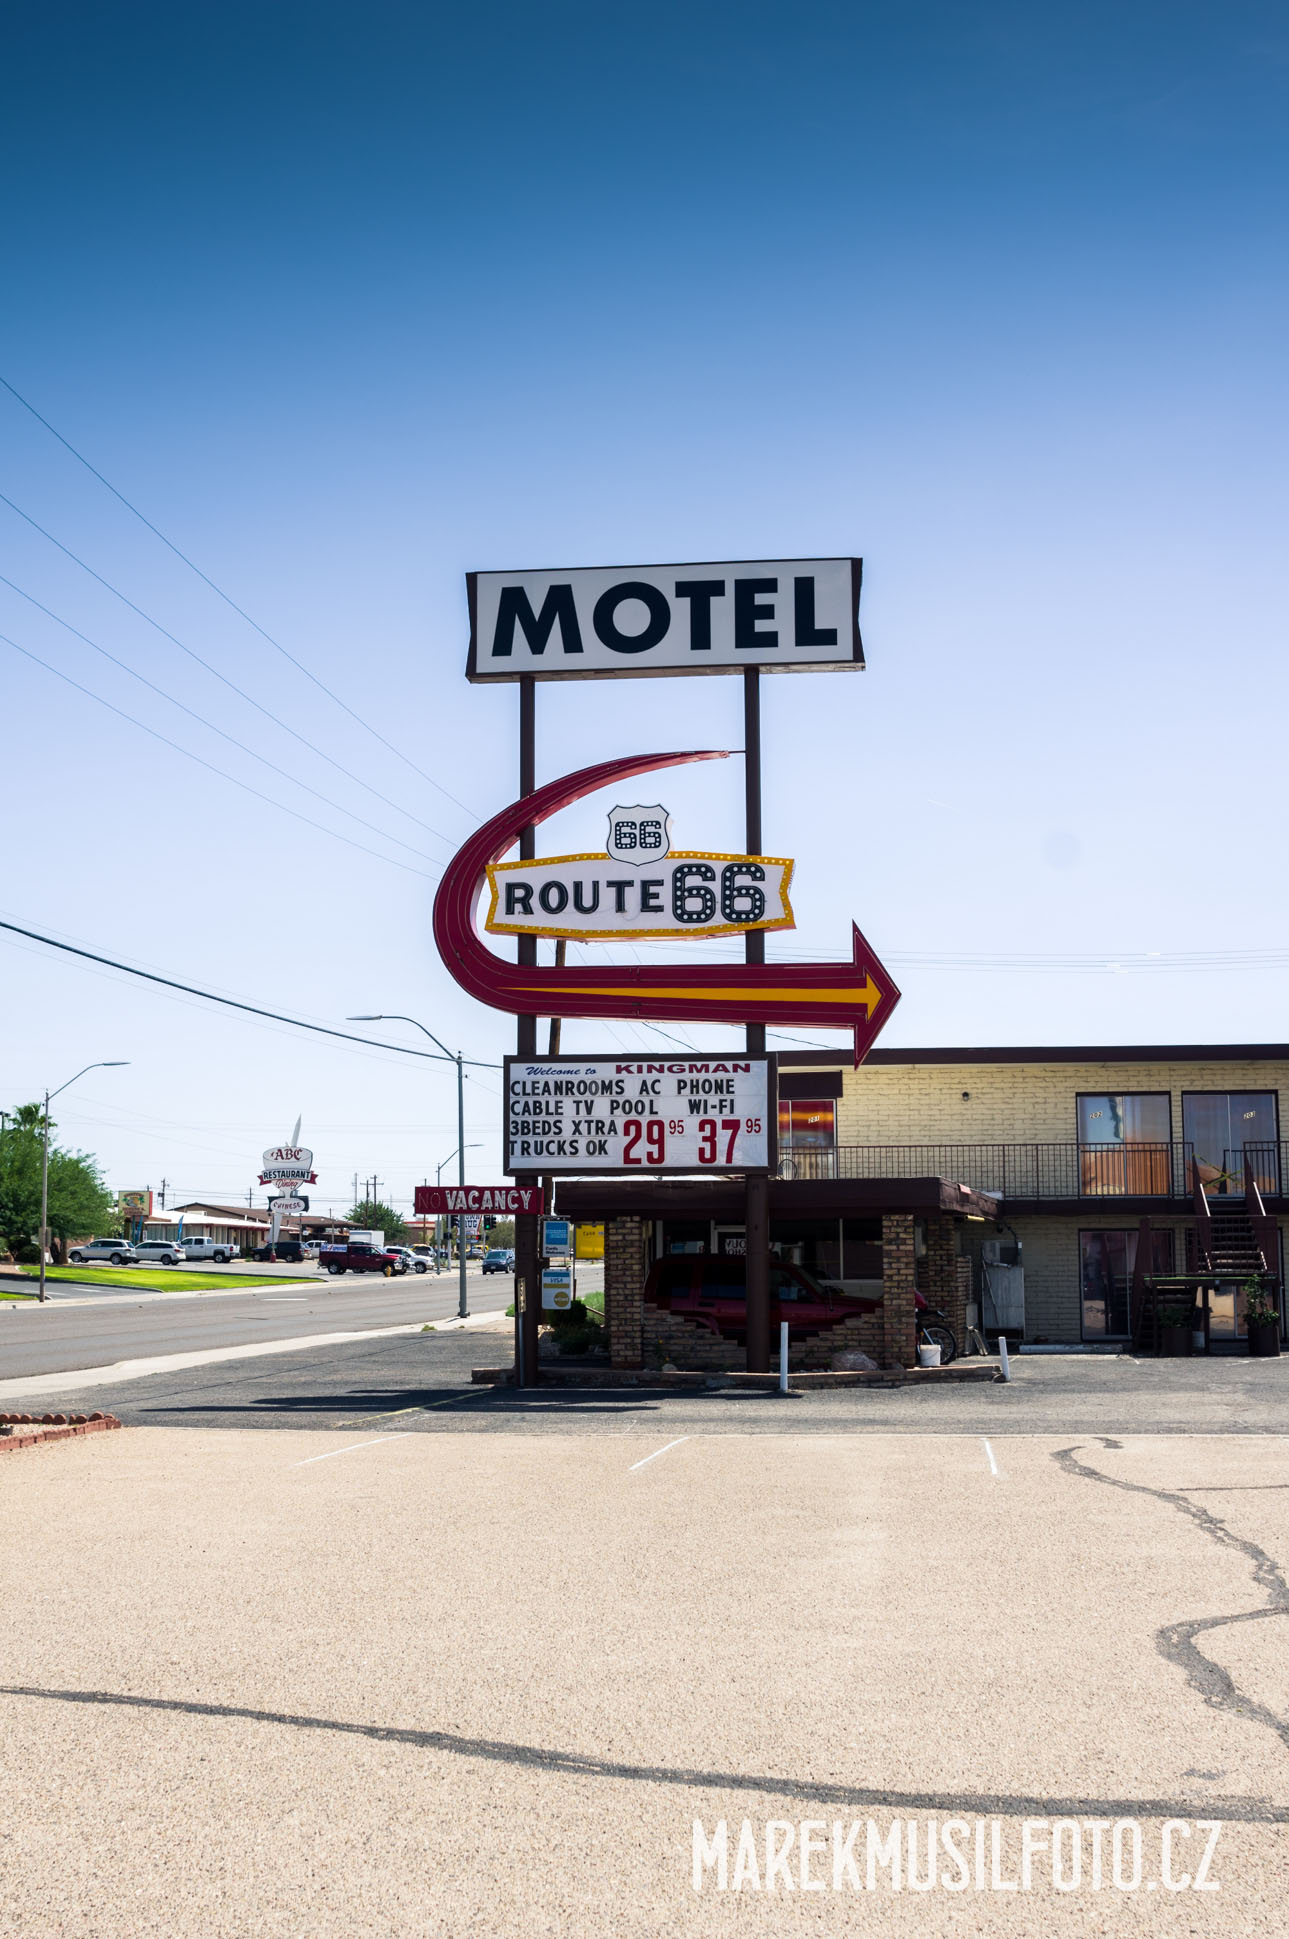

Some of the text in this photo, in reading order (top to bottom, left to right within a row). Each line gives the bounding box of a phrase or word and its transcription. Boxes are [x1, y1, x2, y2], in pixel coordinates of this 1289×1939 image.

[491, 576, 838, 657] MOTEL
[614, 821, 662, 850] 66
[505, 863, 766, 924] ROUTE 66
[525, 1063, 751, 1076] Welcome to KINGMAN
[510, 1078, 735, 1096] CLEANROOMS AC PHONE
[510, 1099, 735, 1116] CABLE TV POOL WI-FI
[510, 1119, 618, 1136] 3BEDS XTRA
[509, 1140, 609, 1156] TRUCKS OK
[623, 1118, 762, 1164] 29 95 37 95
[270, 1148, 303, 1161] ABC
[263, 1170, 311, 1180] RESTAURANT
[275, 1179, 299, 1190] Dining
[273, 1201, 303, 1210] CHINESE
[418, 1190, 533, 1210] NO VACANCY
